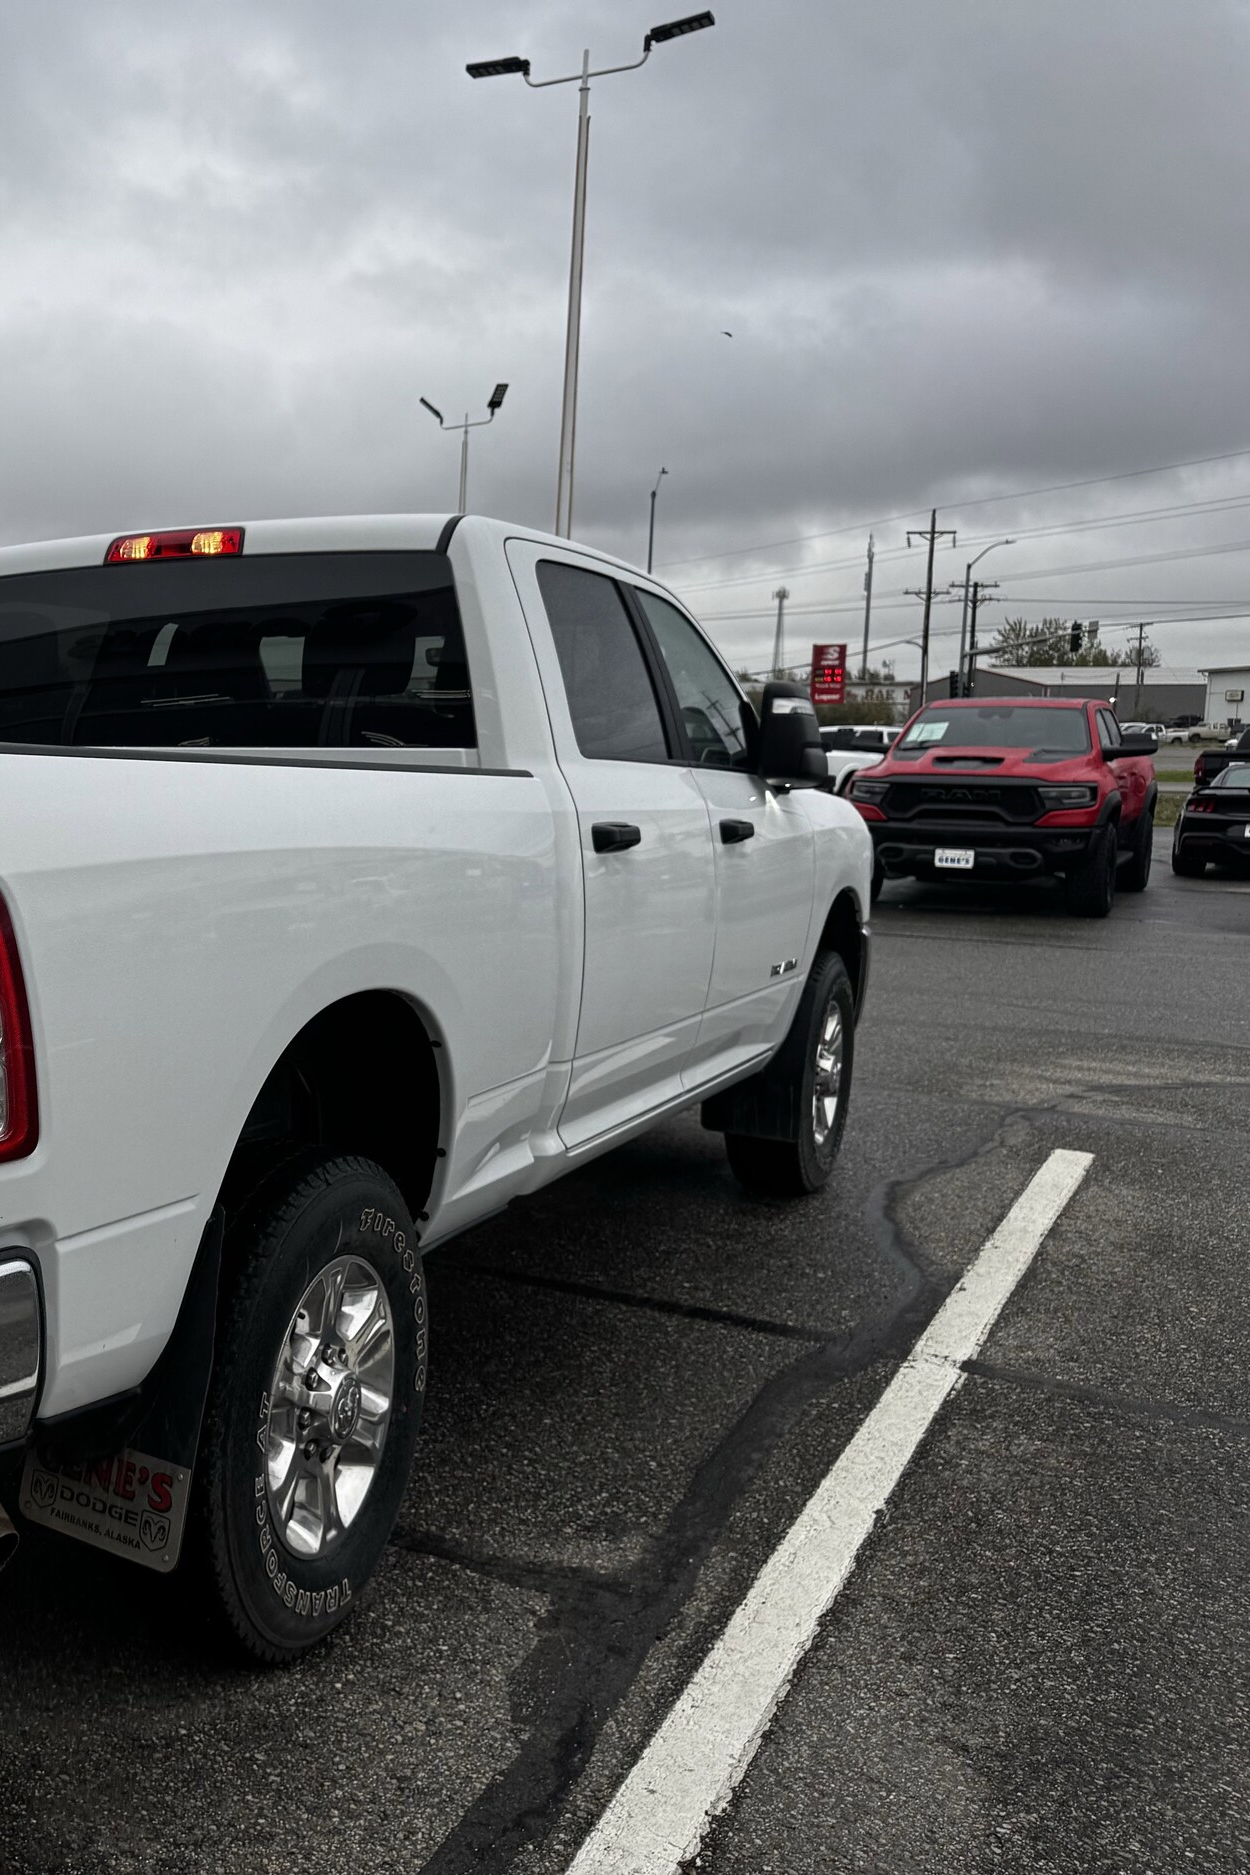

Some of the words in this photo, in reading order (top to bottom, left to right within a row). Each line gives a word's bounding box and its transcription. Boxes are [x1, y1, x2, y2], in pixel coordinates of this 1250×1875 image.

[60, 1485, 139, 1527] DODGE
[50, 1507, 103, 1536] FAIRBANKS,
[104, 1528, 141, 1549] ALASKA
[254, 1473, 352, 1616] TRANSFORCE
